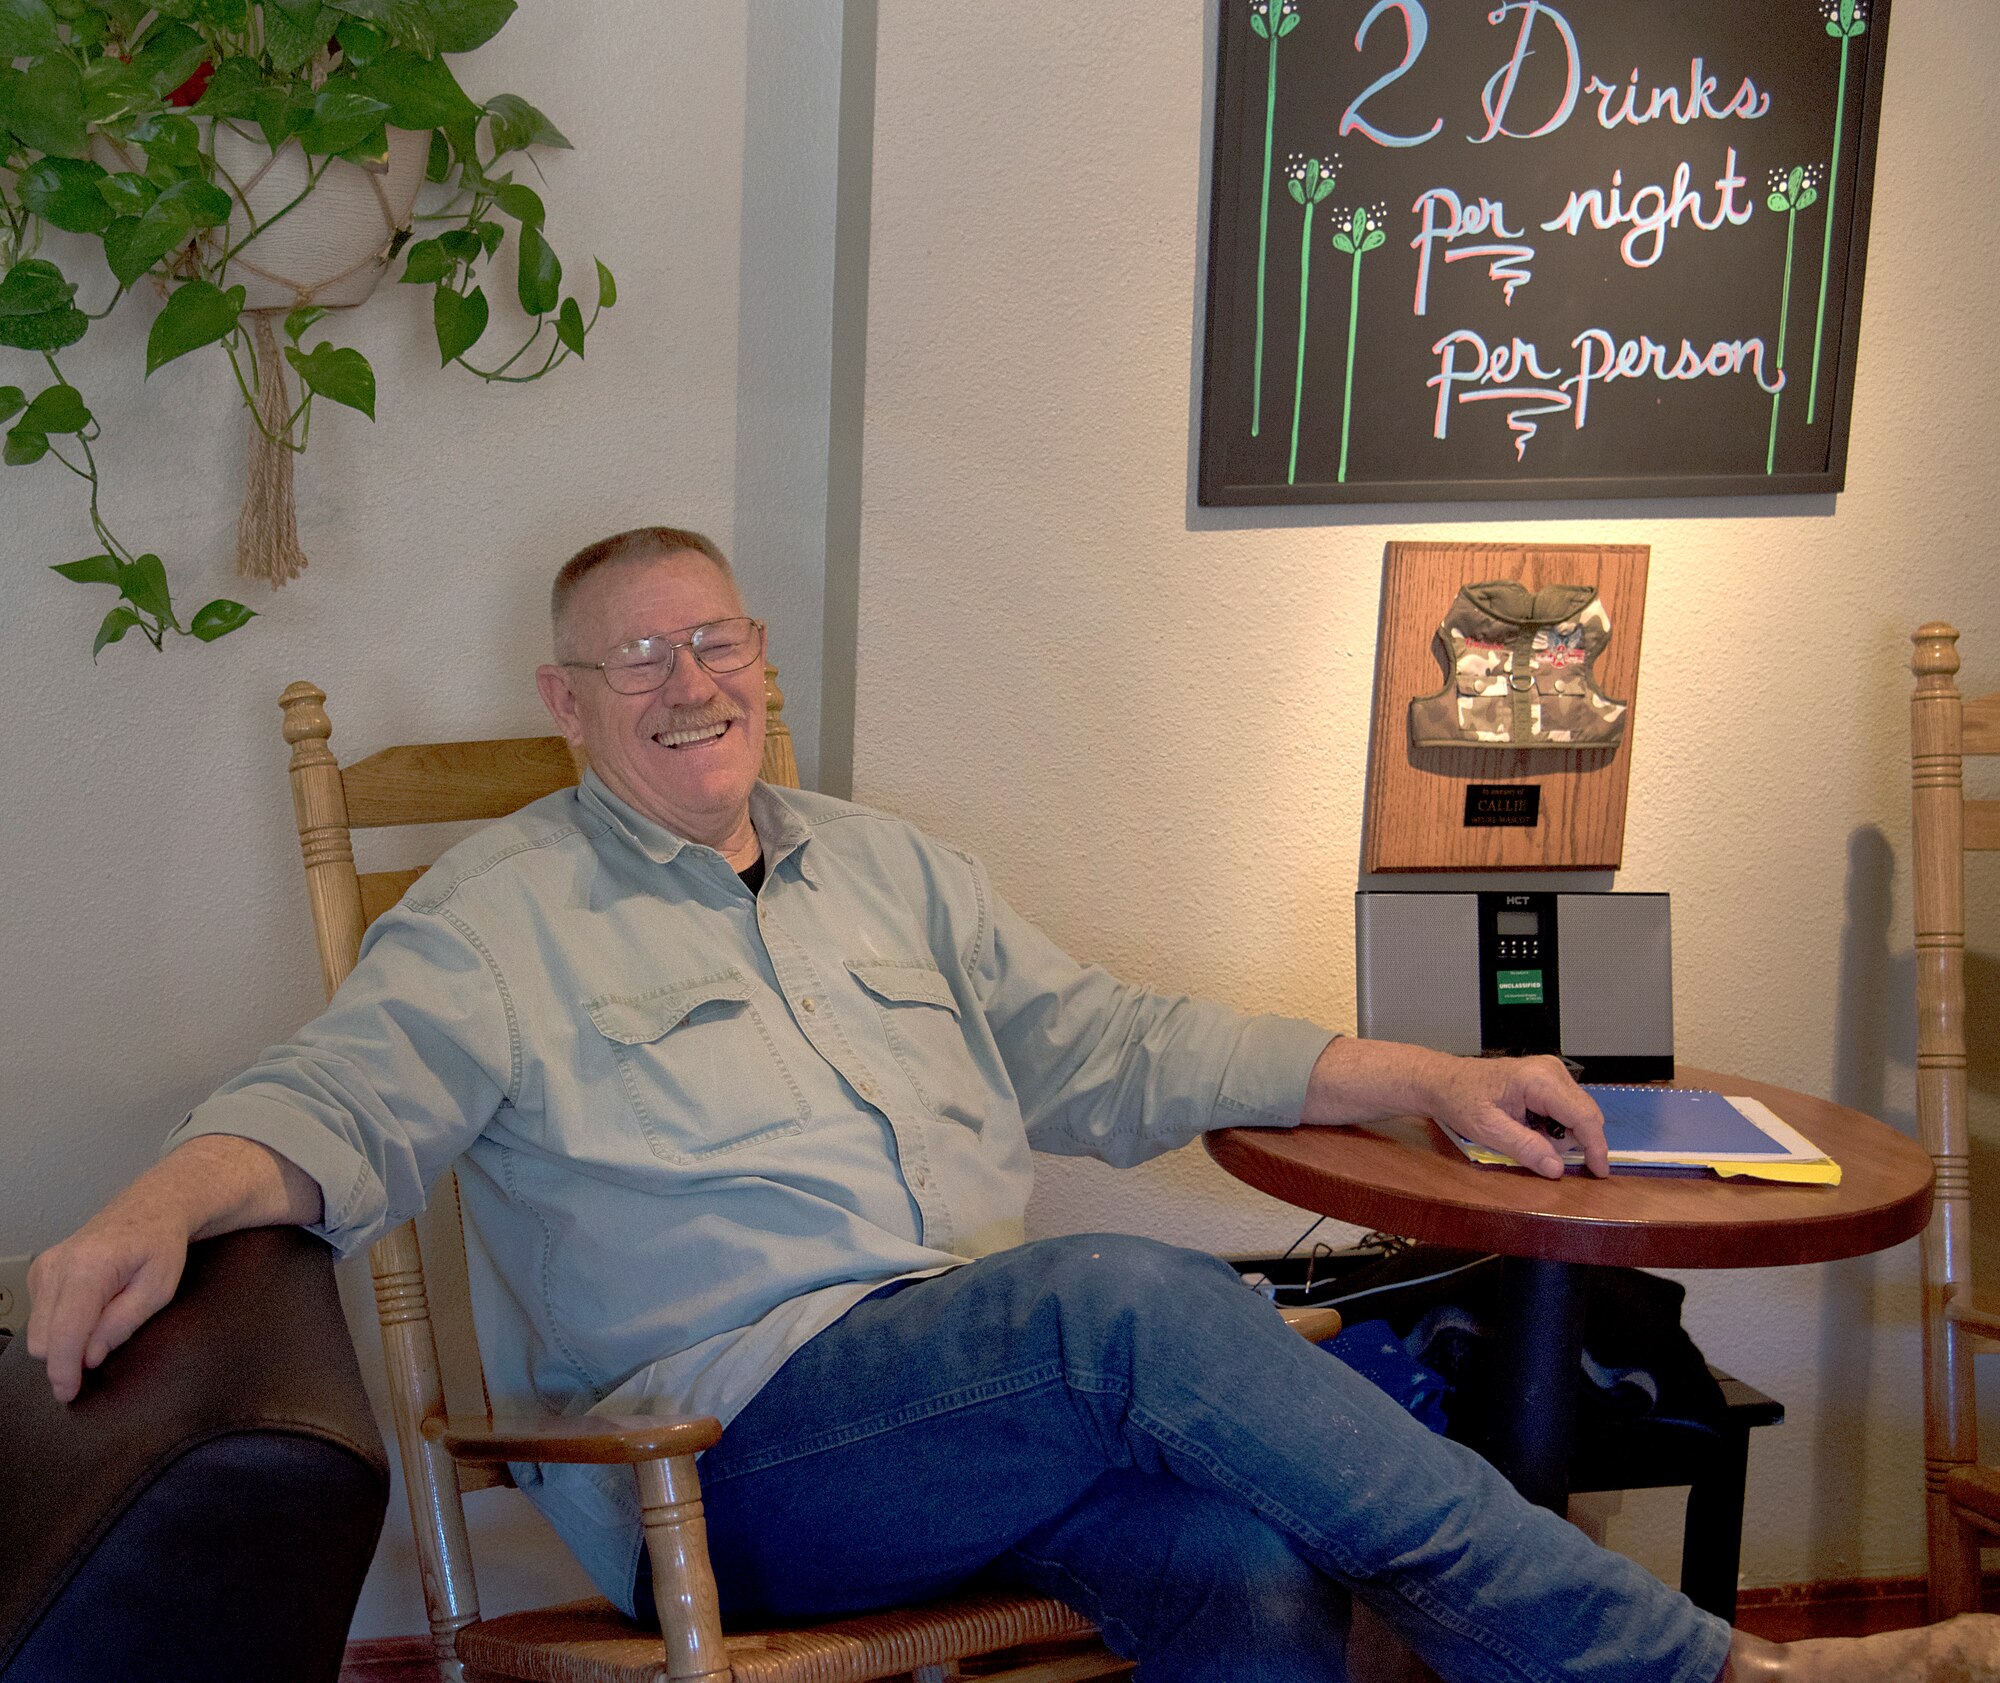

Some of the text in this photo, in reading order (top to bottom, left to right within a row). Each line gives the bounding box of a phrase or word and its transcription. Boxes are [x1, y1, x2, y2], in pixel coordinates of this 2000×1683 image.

[1339, 0, 1770, 148] 2 Drinks
[1541, 146, 1753, 268] night
[1559, 328, 1787, 430] person
[1478, 800, 1528, 812] CALLIE
[1506, 896, 1530, 905] HCT
[1499, 982, 1541, 990] UNCLASSIFIED
